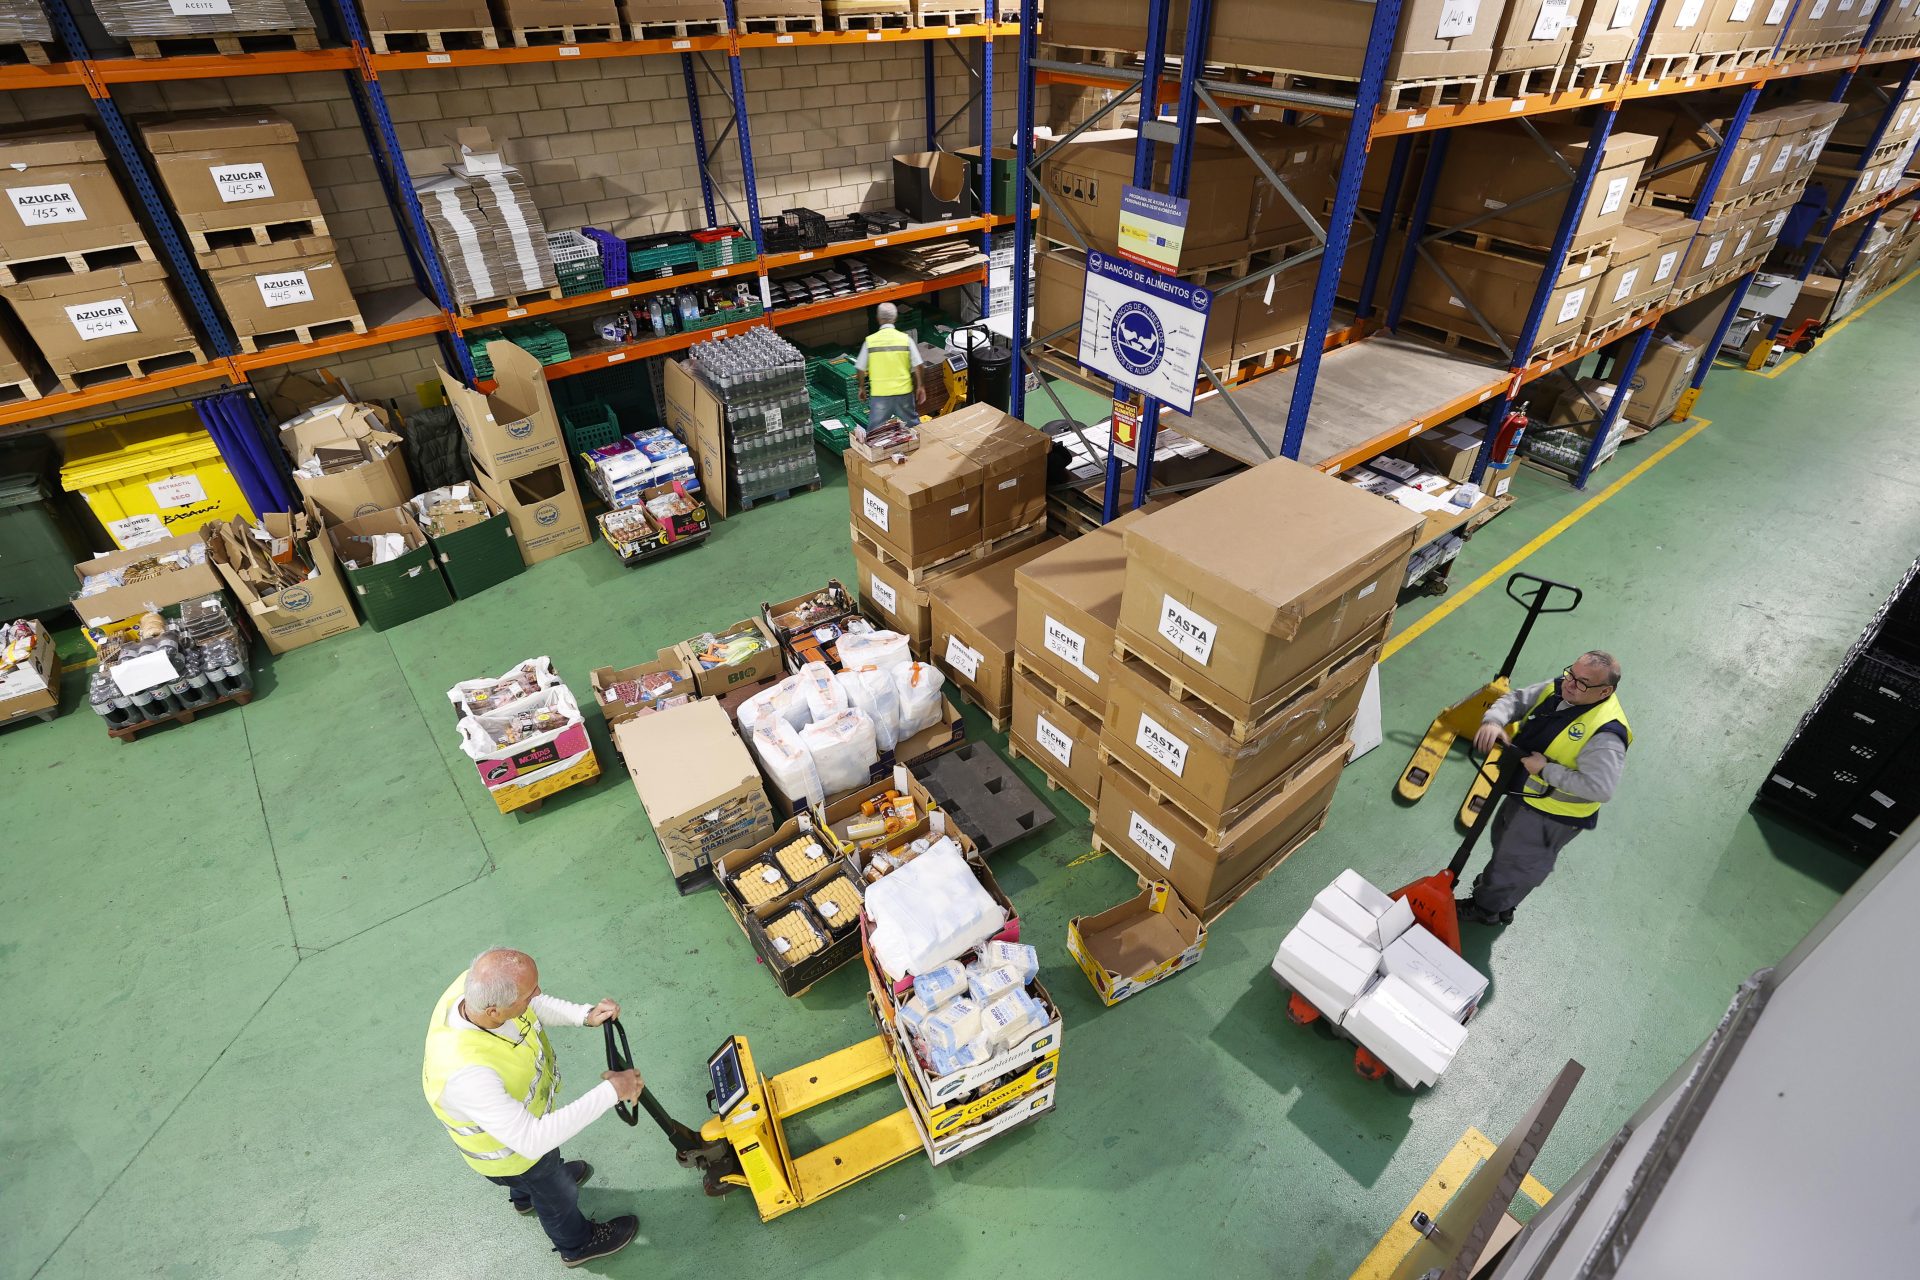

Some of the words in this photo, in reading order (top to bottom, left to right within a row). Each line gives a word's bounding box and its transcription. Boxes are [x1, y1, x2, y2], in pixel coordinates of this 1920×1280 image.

[219, 170, 264, 183] AZUCAR
[228, 183, 255, 195] 455
[18, 193, 71, 206] AZUCAR
[32, 207, 58, 219] 455
[263, 278, 304, 290] AZUCAR
[1104, 261, 1133, 279] BANCOS
[1134, 273, 1145, 282] DE
[1145, 278, 1190, 299] ALIMENTOS
[76, 306, 124, 321] AZUCAR
[1114, 304, 1133, 325] BANCOS
[1133, 303, 1141, 311] DE
[1142, 306, 1164, 343] ALIMENTOS
[1111, 335, 1126, 366] BANCOS
[1125, 362, 1134, 372] DE
[1134, 354, 1162, 374] ALIMENTOS
[170, 493, 191, 501] SECO
[866, 497, 885, 516] LECHE
[874, 582, 892, 600] LECHE
[270, 622, 302, 635] CONSERVAS
[305, 615, 322, 624] ACEITE
[325, 609, 342, 618] LECHE
[1167, 608, 1207, 643] PASTA
[1049, 626, 1079, 651] LECHE
[727, 666, 757, 686] BIO
[1041, 724, 1067, 750] LECHE
[1144, 725, 1181, 759] PASTA
[1135, 822, 1169, 854] PASTA
[991, 1008, 1005, 1026] BLANCO
